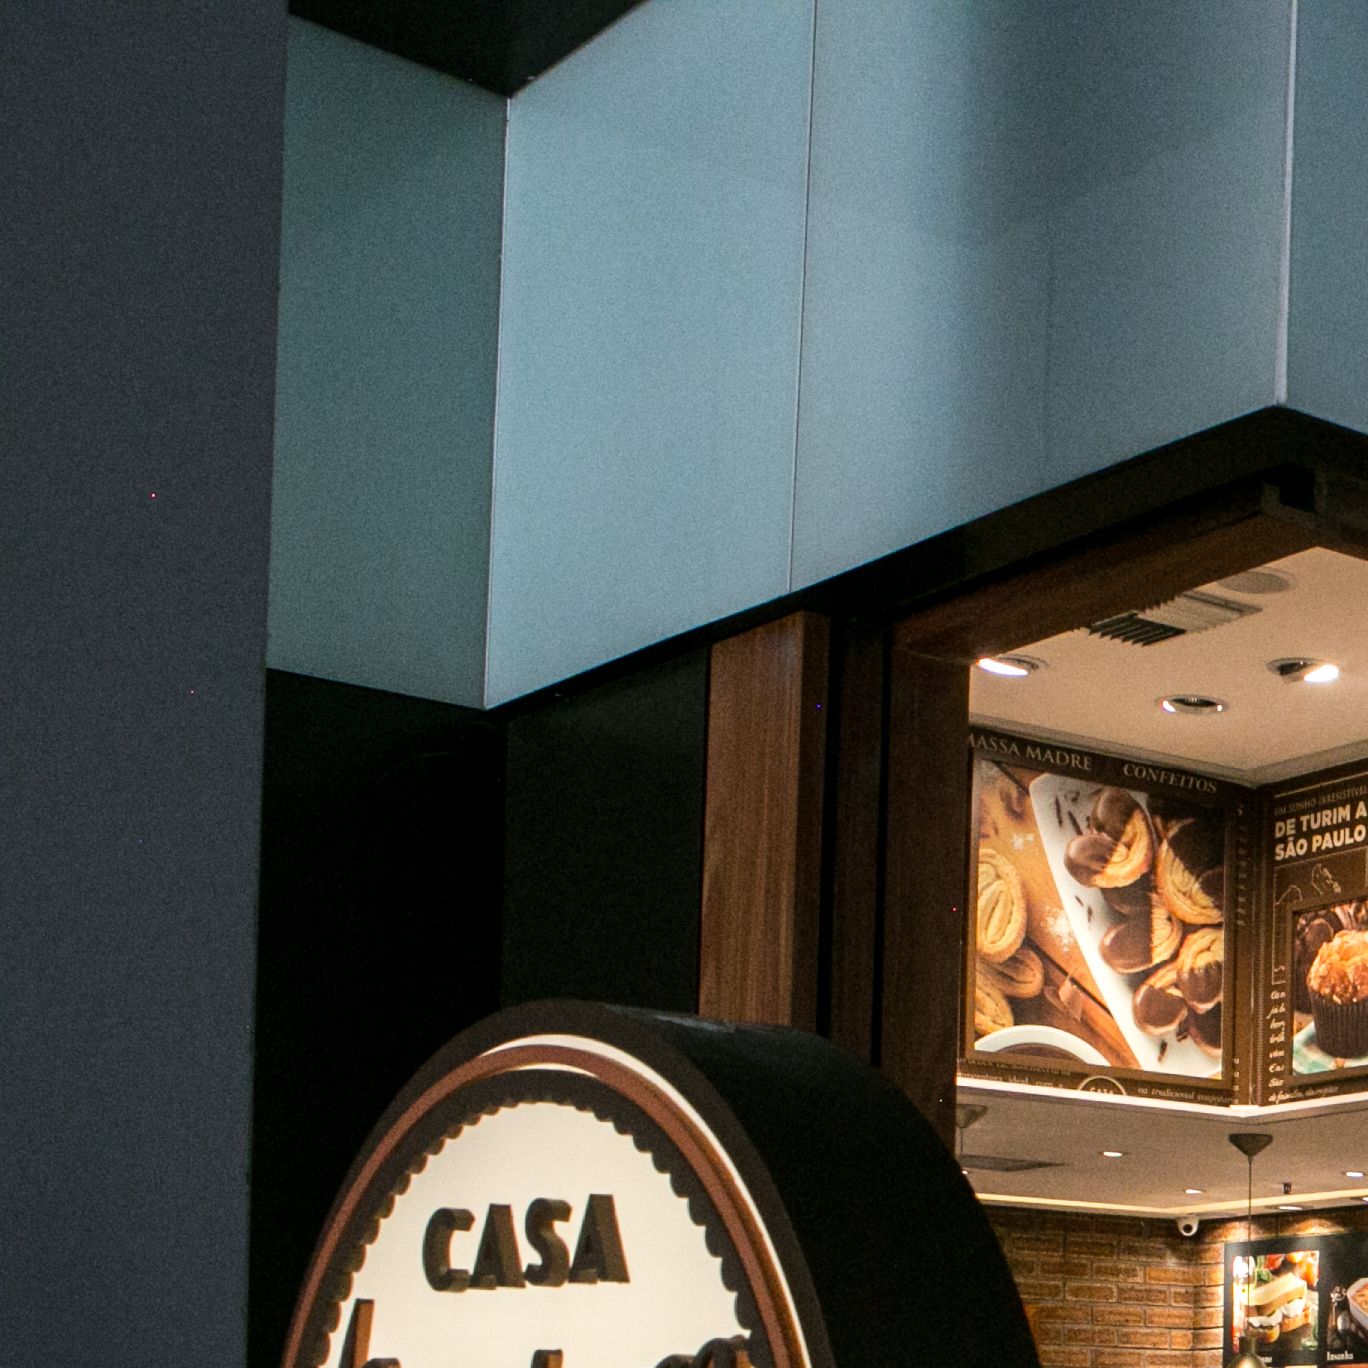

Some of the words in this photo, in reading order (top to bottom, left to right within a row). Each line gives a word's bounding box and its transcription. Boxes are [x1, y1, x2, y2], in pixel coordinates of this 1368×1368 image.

[1026, 745, 1094, 771] MADRE
[1123, 763, 1218, 794] CONFEITOS
[1275, 818, 1296, 839] DE
[1300, 804, 1350, 832] TURIM
[1355, 801, 1368, 819] A
[1275, 836, 1308, 862] SÃO
[1311, 824, 1367, 853] PAULO
[422, 1193, 631, 1293] CASA
